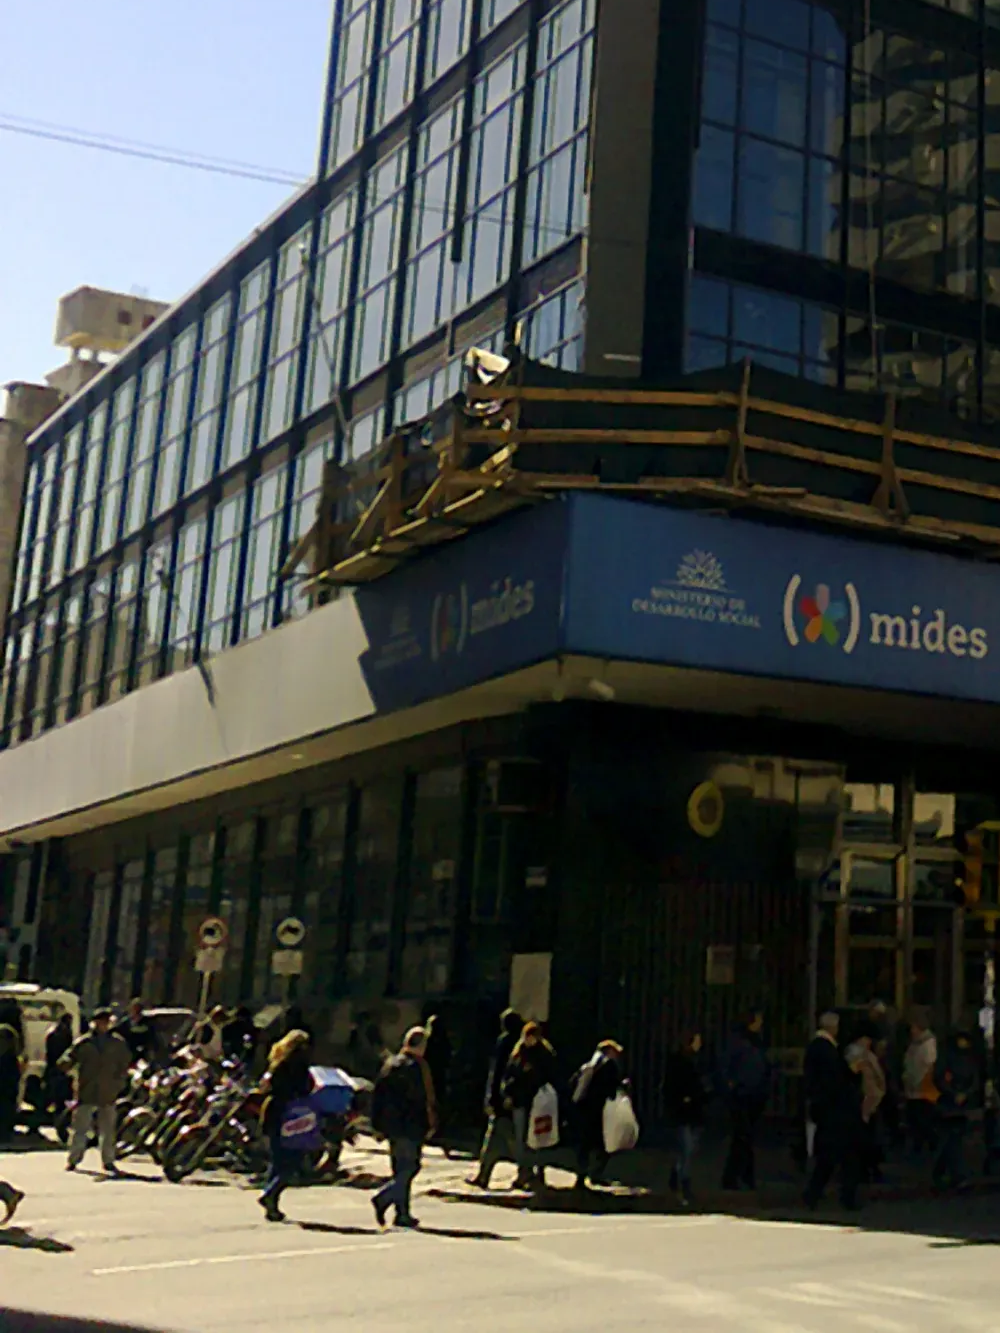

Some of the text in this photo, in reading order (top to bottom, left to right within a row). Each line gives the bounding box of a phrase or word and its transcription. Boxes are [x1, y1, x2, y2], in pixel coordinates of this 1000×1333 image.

[631, 598, 761, 629] DESARROLLO SOCIAL
[650, 586, 746, 612] MINISTERIO DE
[869, 604, 988, 659] mides
